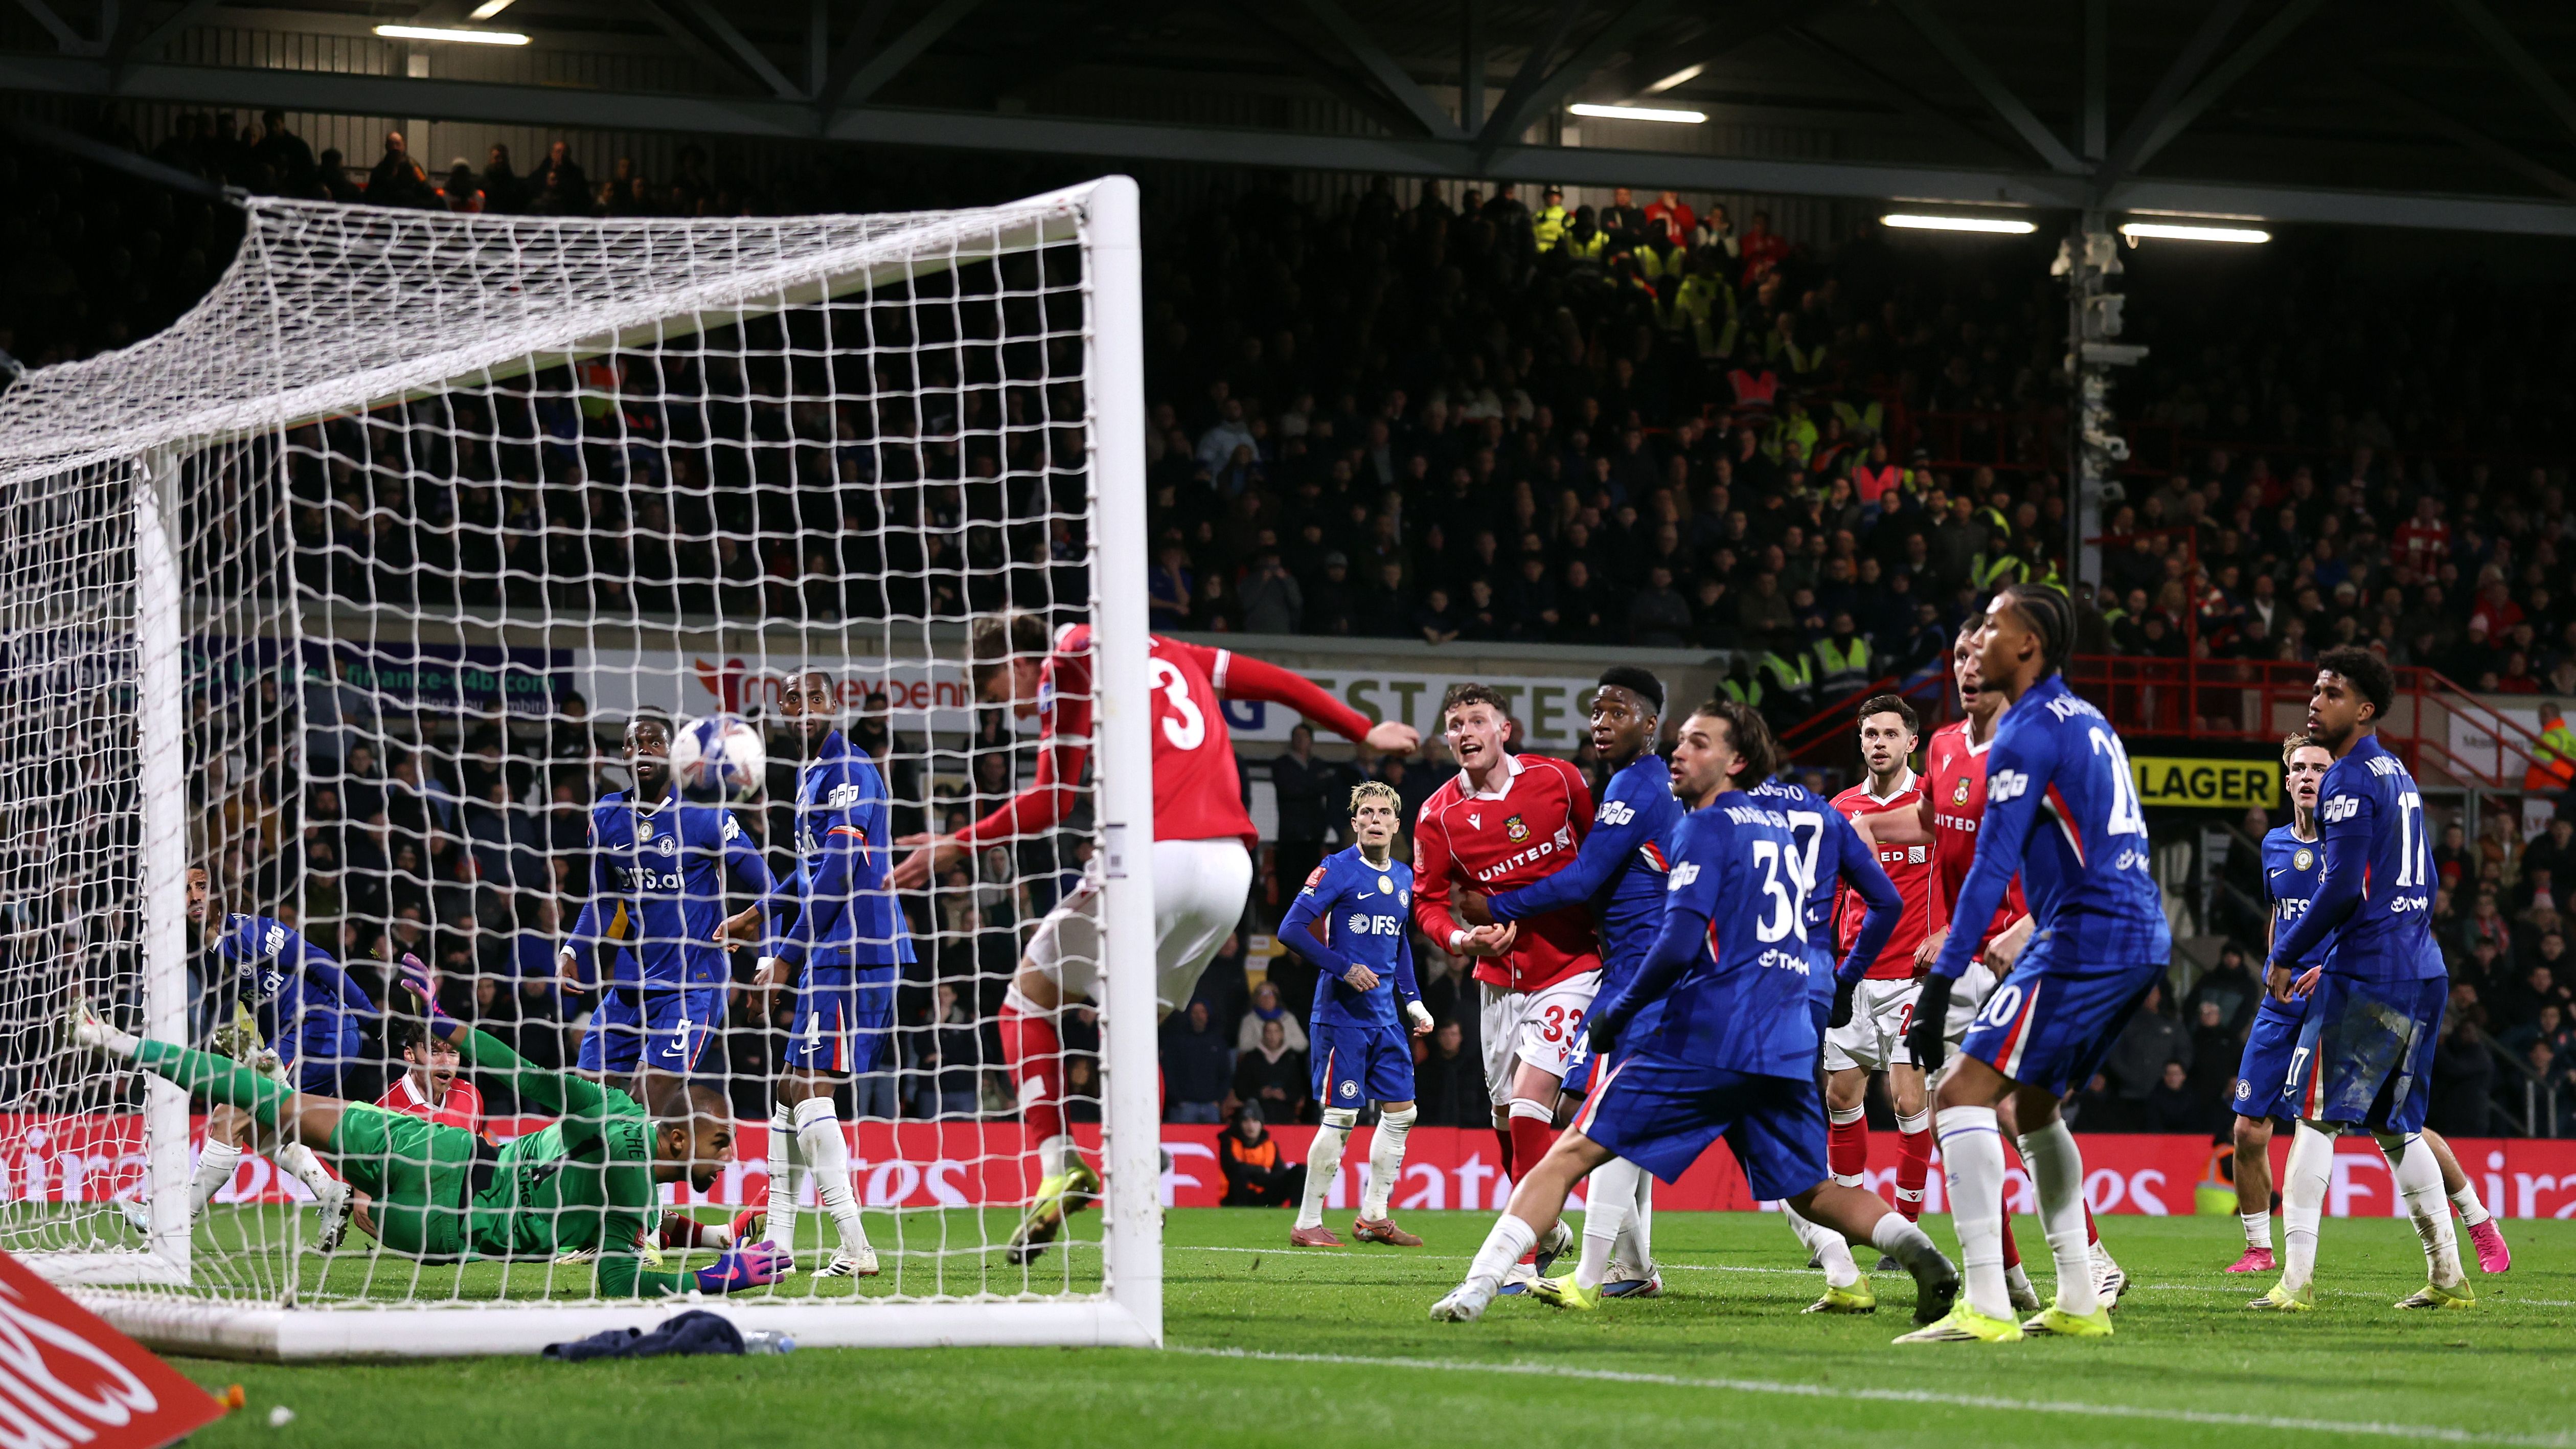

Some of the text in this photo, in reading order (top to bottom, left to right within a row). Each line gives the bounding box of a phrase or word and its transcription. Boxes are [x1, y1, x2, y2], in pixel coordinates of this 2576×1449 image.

[829, 787, 858, 804] FPT
[2139, 765, 2269, 802] LAGER
[1601, 803, 1634, 823] FPT
[1934, 812, 1976, 832] NITED
[2324, 798, 2358, 819] FPT
[1477, 842, 1553, 882] UNITED
[1787, 809, 1824, 891] 7
[629, 866, 685, 889] IFS.ai
[2281, 898, 2311, 920] IFS
[671, 1018, 693, 1050] 5
[804, 1011, 821, 1045] 4
[1543, 1005, 1584, 1049] 33
[2285, 1046, 2310, 1086] 17
